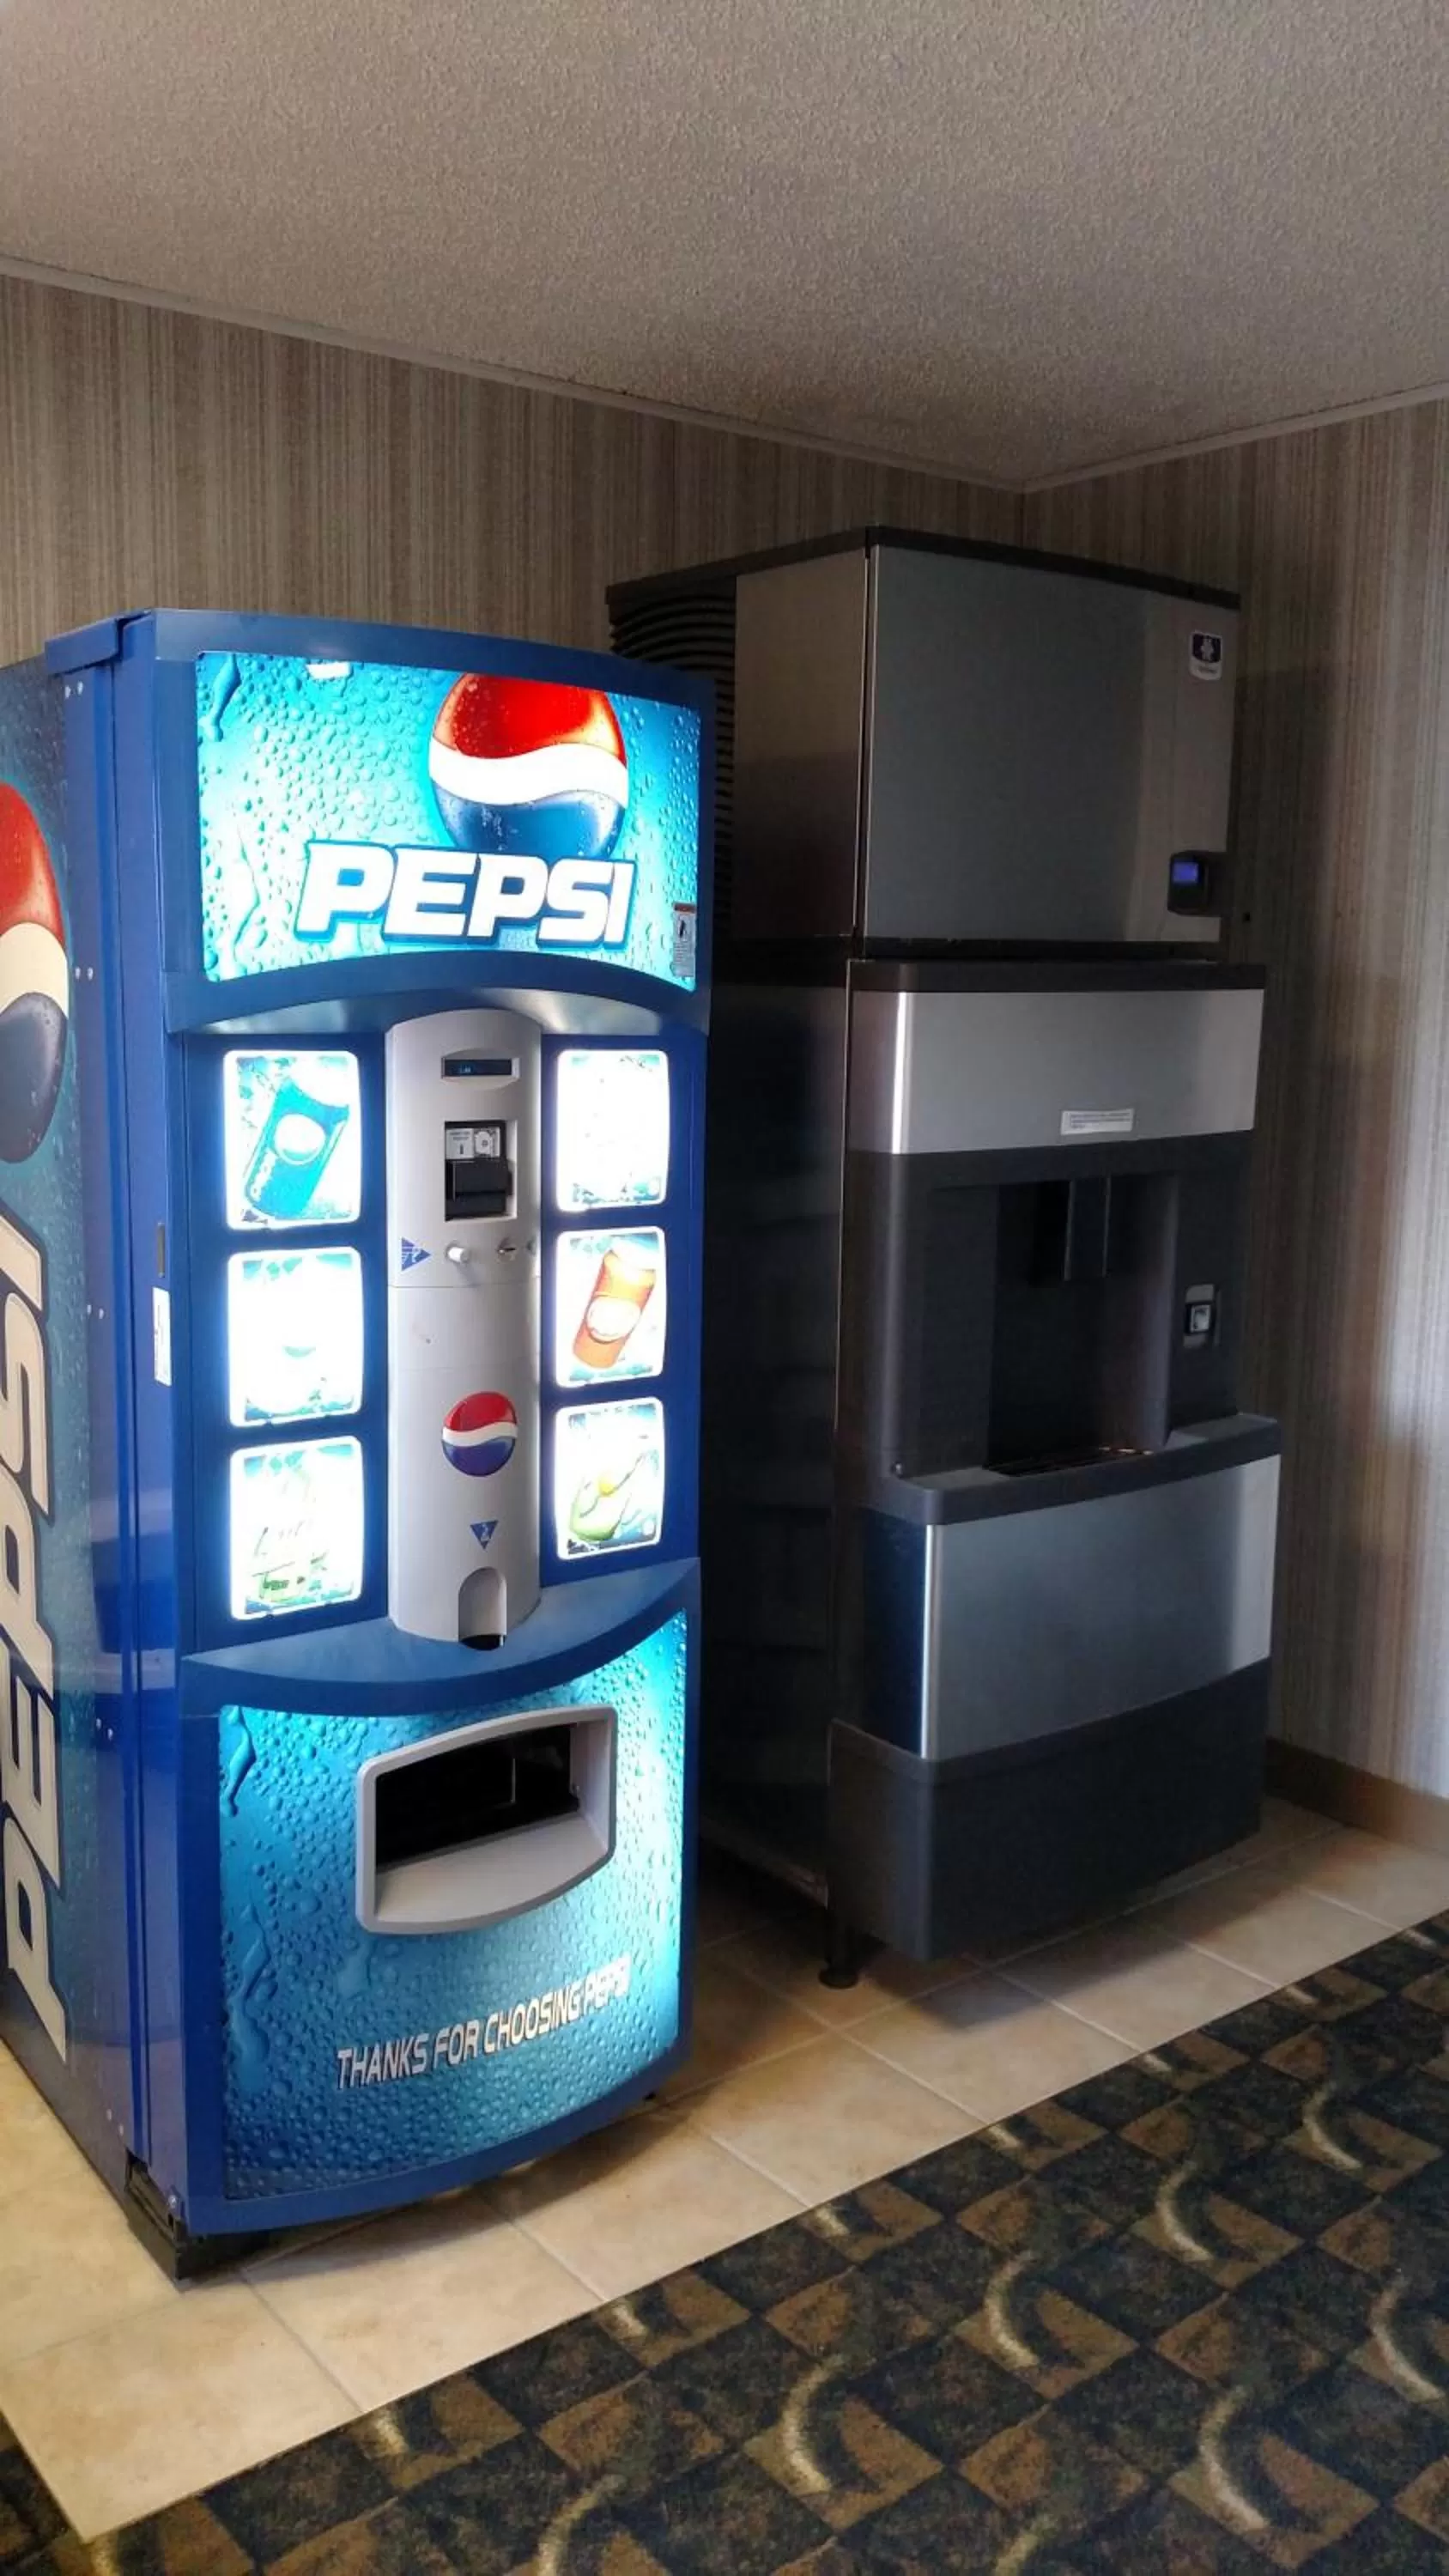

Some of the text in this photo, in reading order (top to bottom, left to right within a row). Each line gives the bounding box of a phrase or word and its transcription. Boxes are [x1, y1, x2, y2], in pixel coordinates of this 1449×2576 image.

[294, 842, 636, 946] PEPSI
[337, 2034, 428, 2089] THANKS
[434, 2020, 479, 2069] FOR
[484, 1982, 582, 2052] CHOOSING
